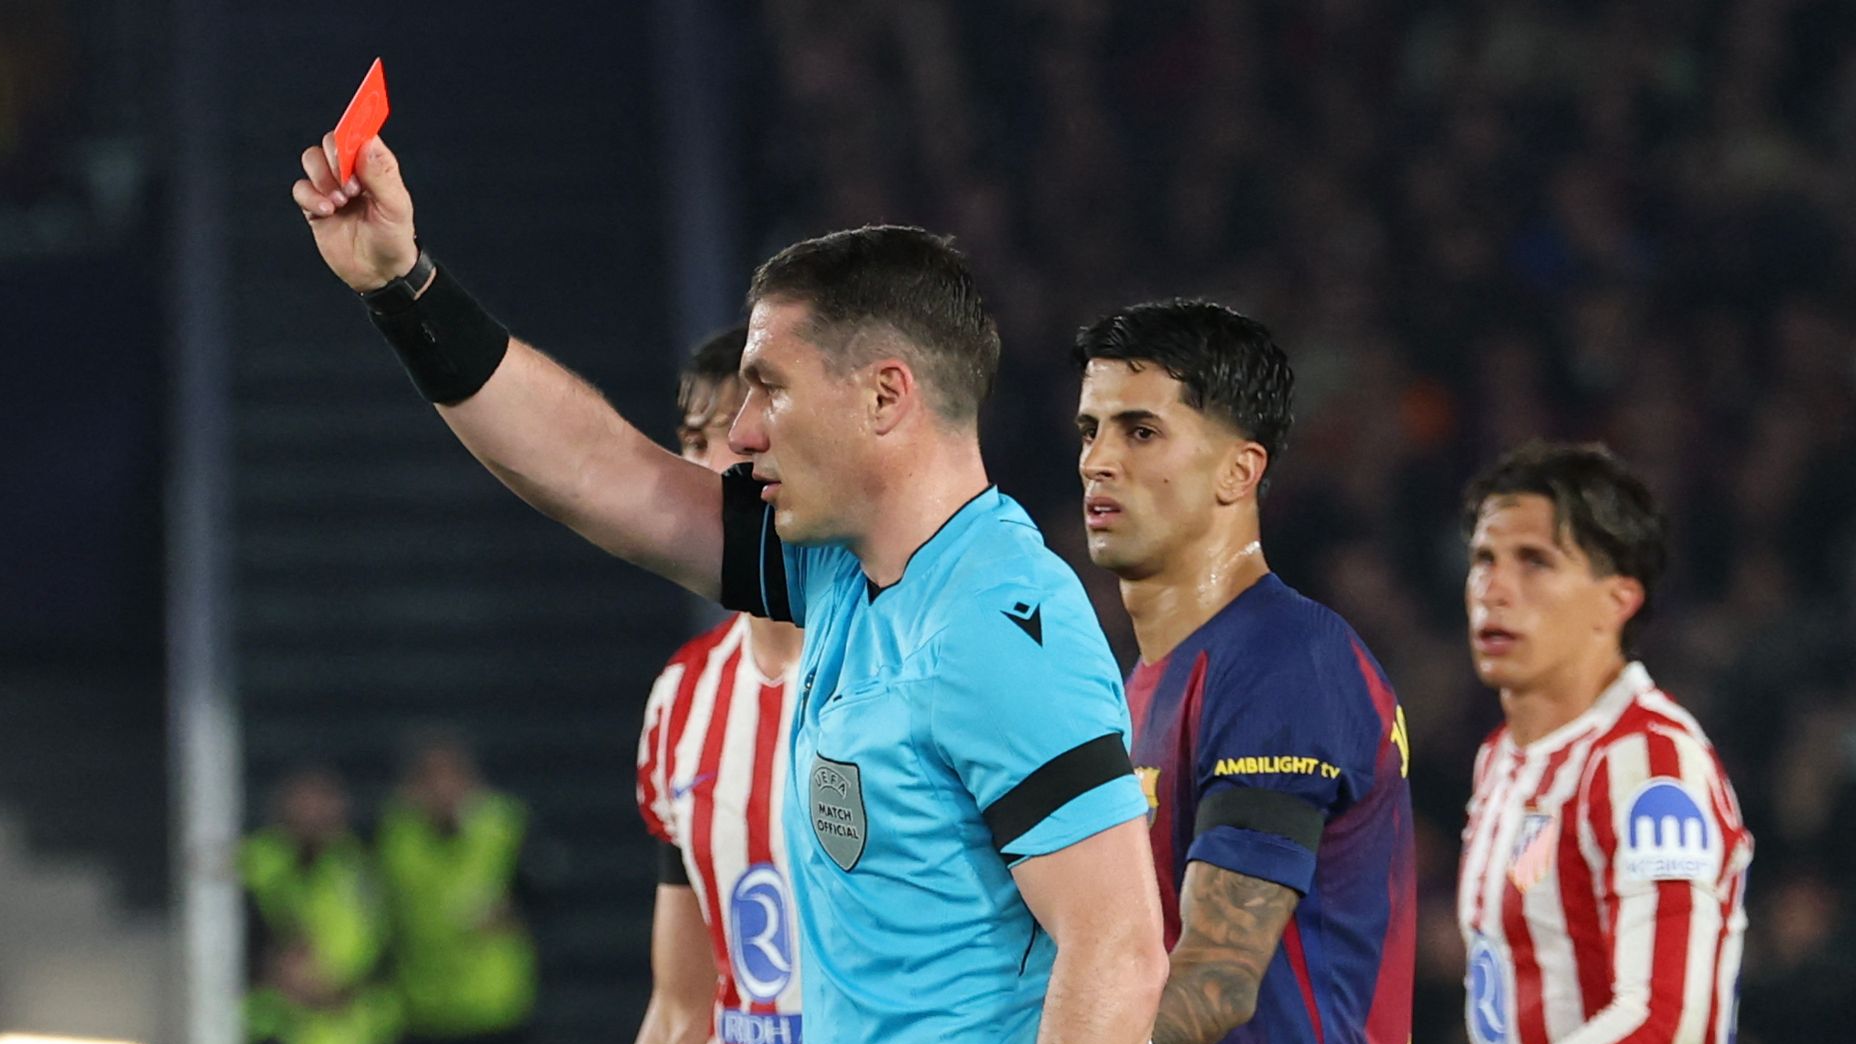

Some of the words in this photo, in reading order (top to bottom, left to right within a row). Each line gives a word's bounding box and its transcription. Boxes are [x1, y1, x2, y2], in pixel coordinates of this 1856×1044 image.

[1214, 755, 1318, 776] AMBILIGHT
[1320, 762, 1341, 779] tv
[818, 803, 852, 822] MATCH
[817, 819, 859, 840] OFFICIAL
